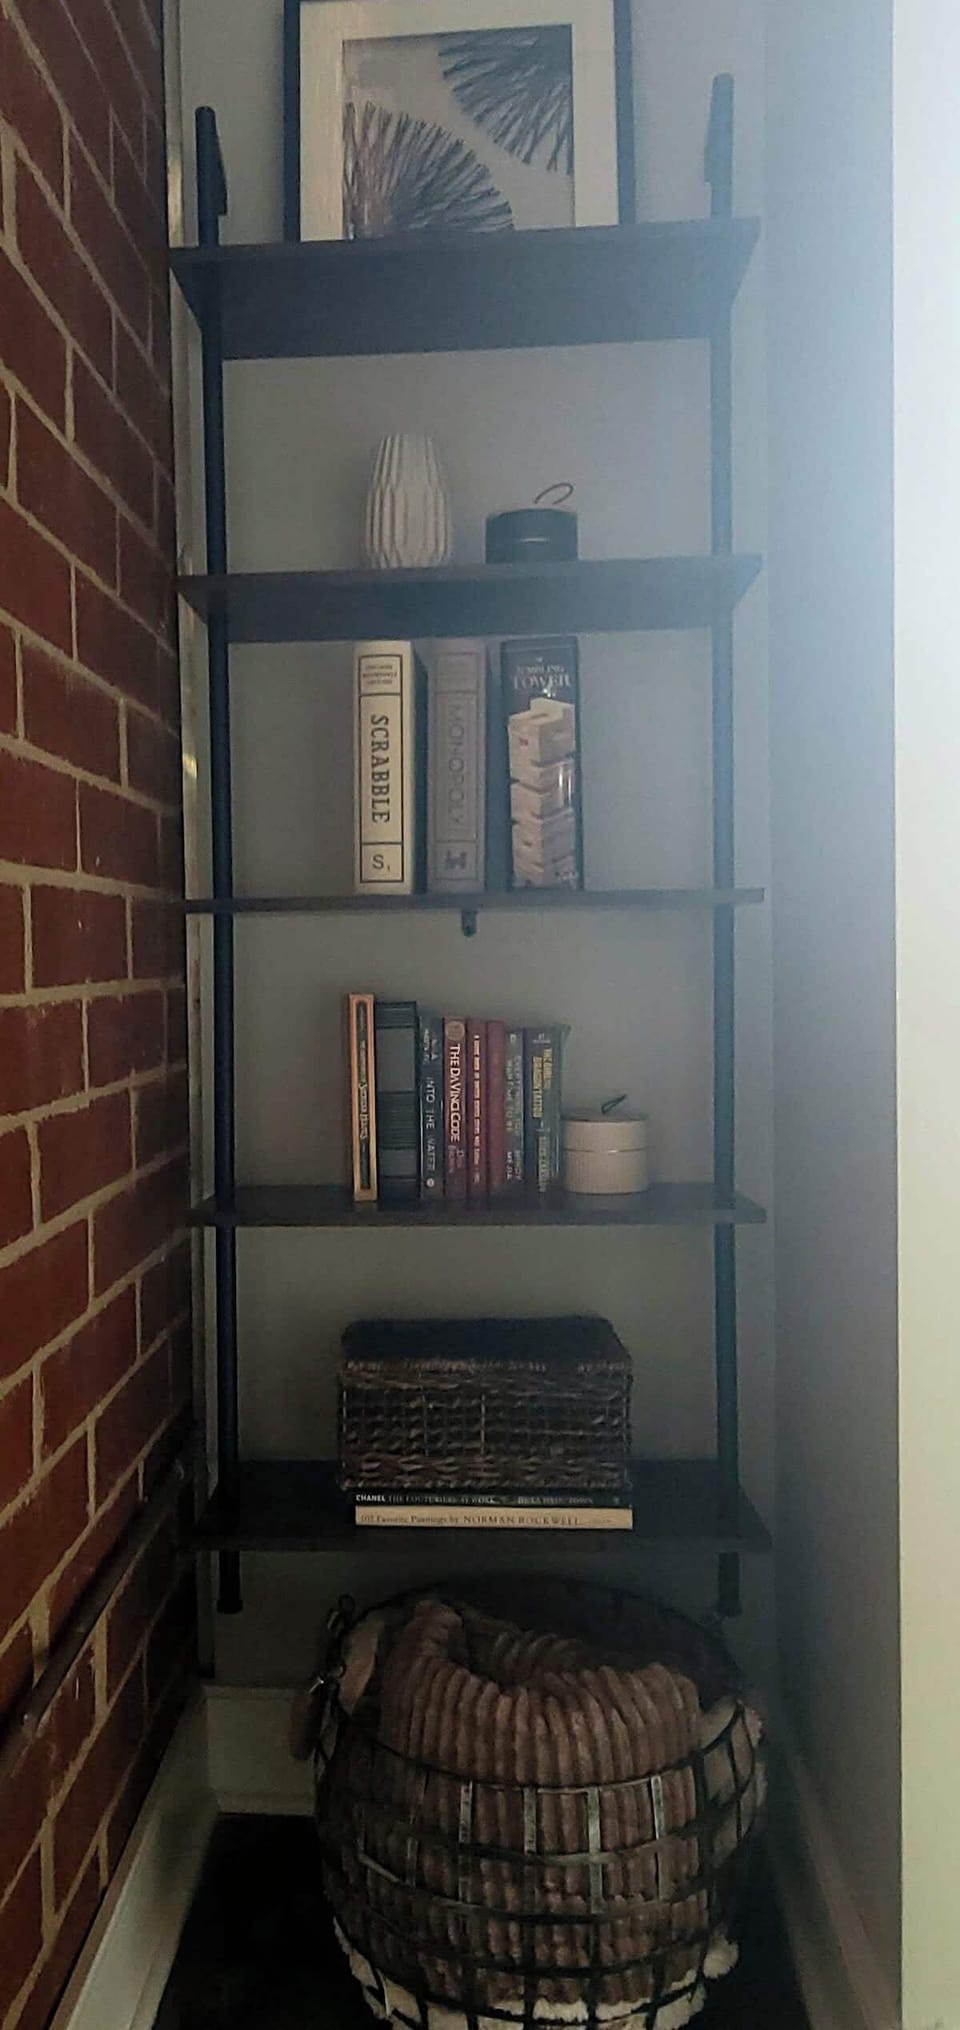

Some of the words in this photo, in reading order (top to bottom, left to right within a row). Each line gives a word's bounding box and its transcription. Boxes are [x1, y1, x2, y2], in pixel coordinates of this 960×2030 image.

[512, 673, 572, 690] TOWER
[370, 714, 390, 824] SCRABBLE
[448, 704, 465, 826] MONOPOLY
[450, 1043, 461, 1066] THE
[426, 1078, 436, 1103] INTO
[426, 1107, 436, 1130] THE
[450, 1112, 462, 1143] CODE
[426, 1136, 436, 1172] WATER
[355, 1494, 386, 1502] CHANEL
[463, 1515, 515, 1524] NORMAN
[518, 1516, 579, 1526] ROCKWELL
